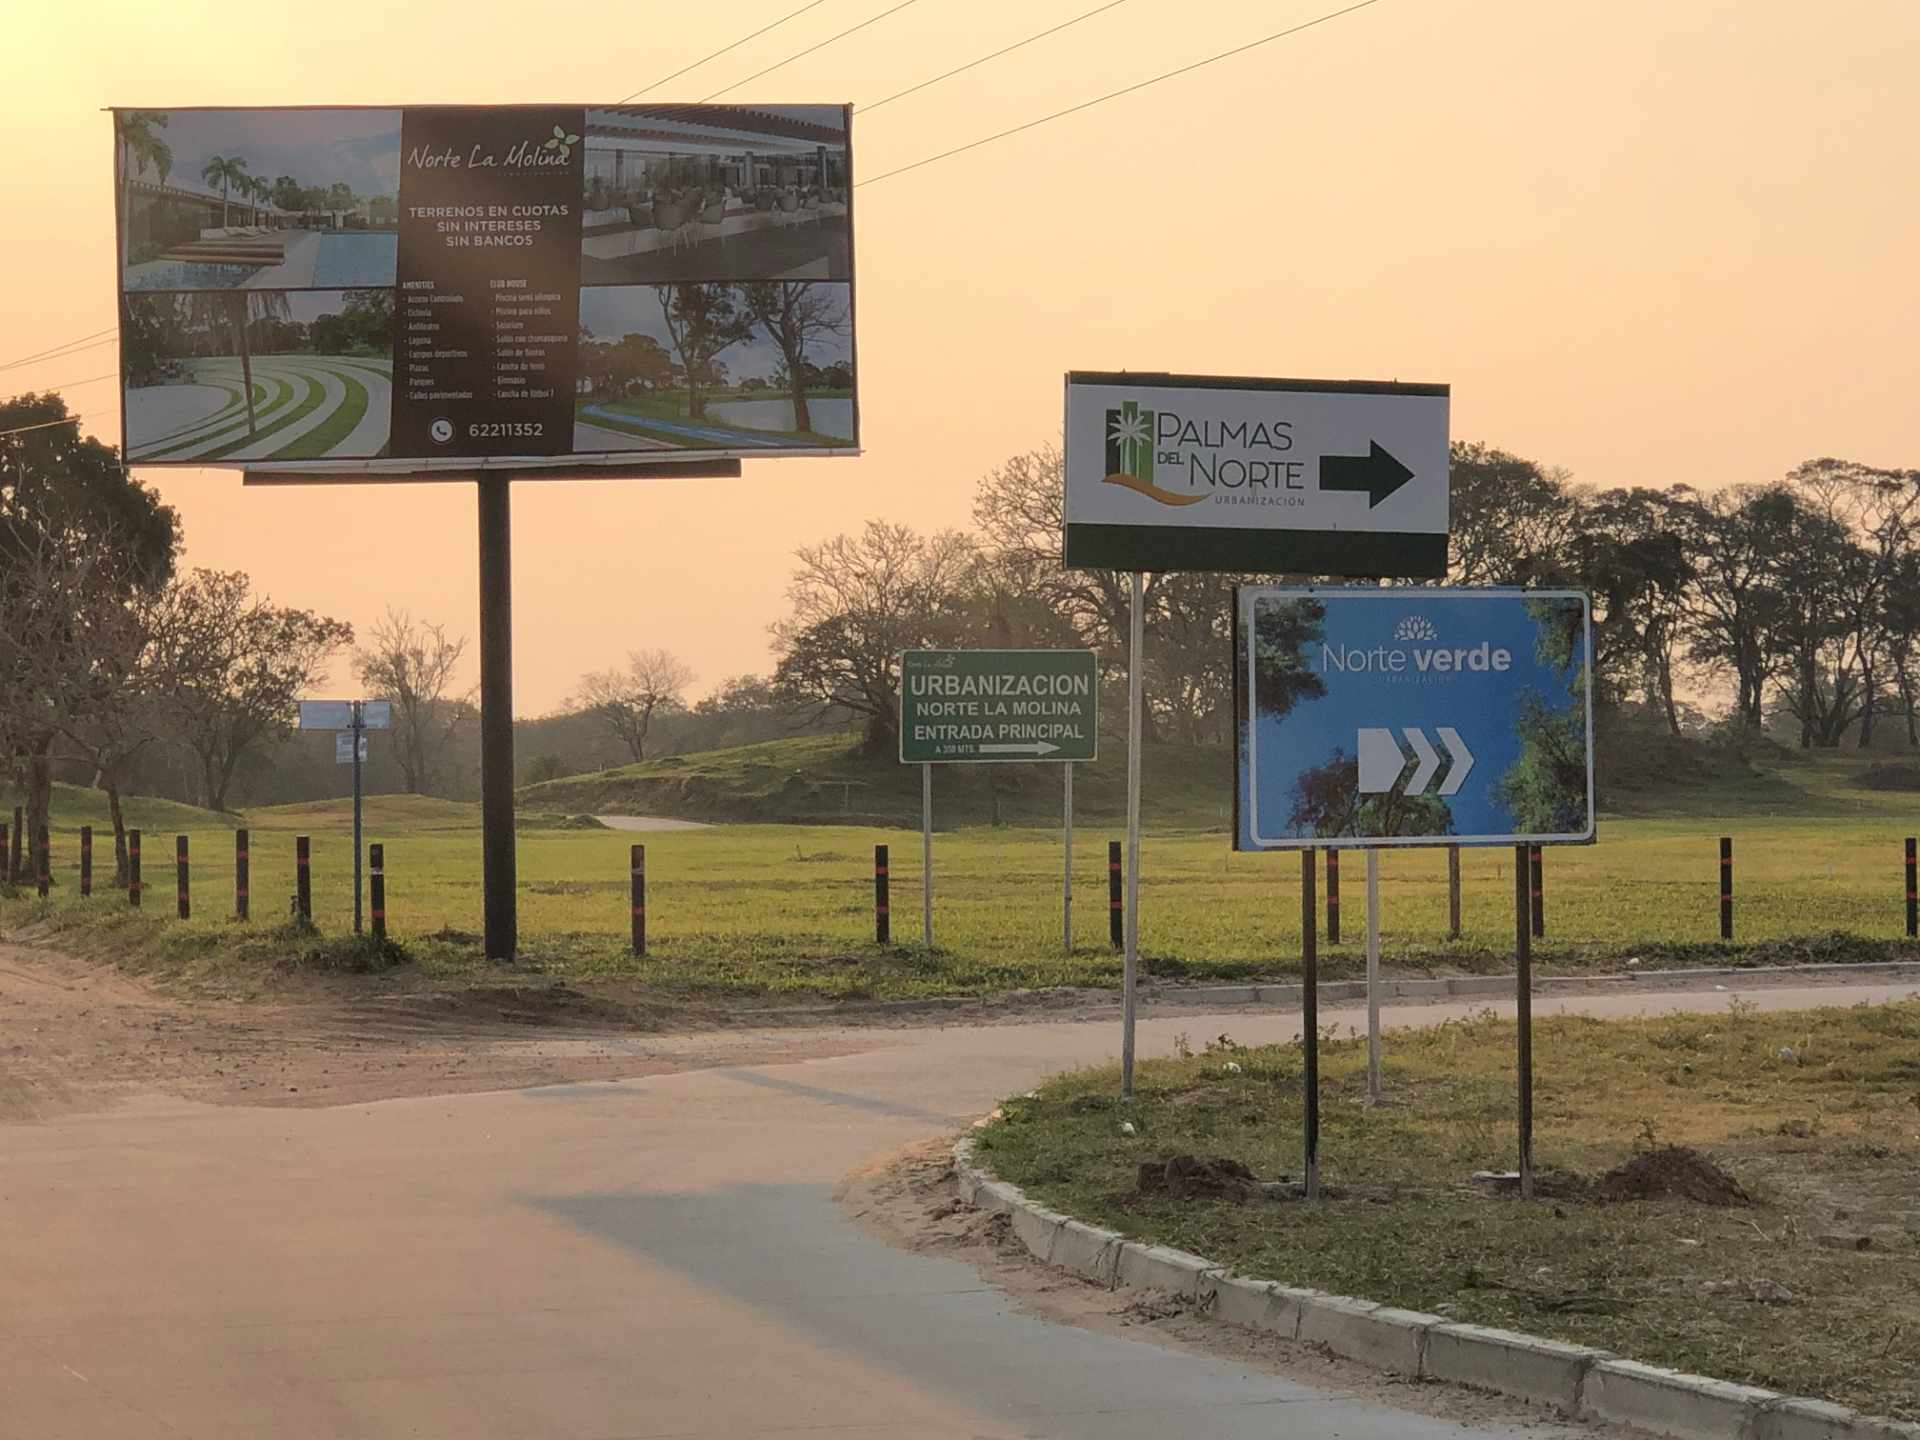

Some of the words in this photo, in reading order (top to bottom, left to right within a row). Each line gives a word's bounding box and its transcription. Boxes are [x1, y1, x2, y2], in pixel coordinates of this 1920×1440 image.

[408, 144, 461, 169] Norte
[468, 144, 498, 168] La
[503, 140, 569, 169] Molina
[408, 206, 484, 218] TERRENOS
[489, 205, 507, 217] EN
[512, 204, 569, 217] CUOTAS
[437, 220, 460, 232] SIN
[465, 220, 541, 231] INTERESES
[446, 235, 470, 247] SIN
[474, 234, 533, 246] BANCOS
[468, 423, 544, 437] 62211352
[1157, 412, 1294, 451] PALMAS
[1157, 452, 1185, 466] DEL
[1189, 453, 1305, 490] NORTE
[1322, 643, 1407, 673] Norte
[1413, 641, 1512, 673] verde
[910, 674, 1090, 697] URBANIZACION
[916, 702, 979, 717] NORTE
[984, 701, 1008, 716] LA
[1012, 700, 1082, 716] MOLINA
[914, 724, 994, 741] ENTRADA
[999, 723, 1085, 740] PRINCIPAL
